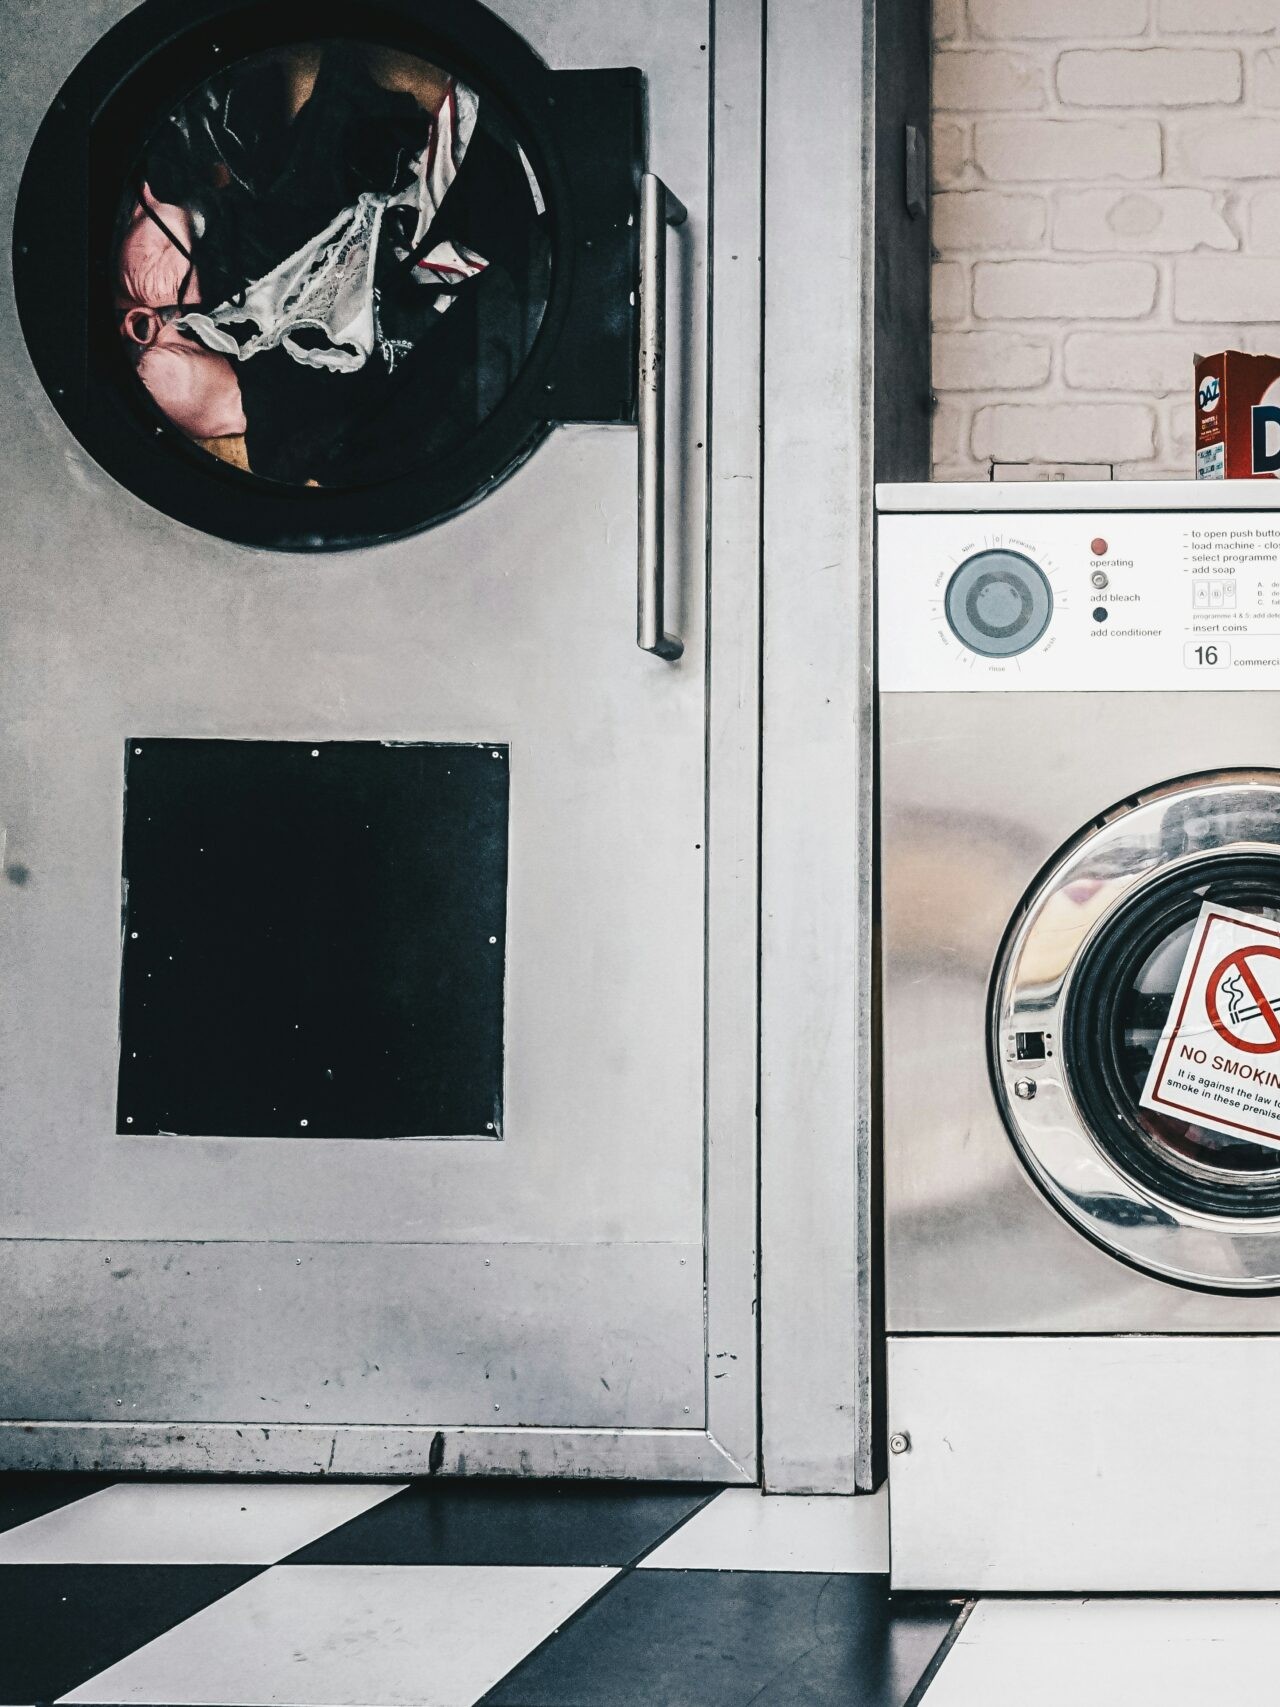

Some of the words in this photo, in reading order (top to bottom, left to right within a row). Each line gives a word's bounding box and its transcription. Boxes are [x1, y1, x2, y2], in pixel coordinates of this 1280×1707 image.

[1199, 378, 1219, 408] DAZ
[1191, 530, 1202, 538] to
[1203, 531, 1228, 539] open
[1229, 529, 1254, 540] push
[1191, 541, 1212, 550] load
[1214, 541, 1255, 550] machine
[1089, 559, 1134, 569] operating
[1191, 554, 1220, 562] select
[1222, 554, 1278, 564] programme
[1191, 565, 1210, 574] add
[1212, 567, 1236, 575] soap
[1090, 593, 1108, 602] add
[1109, 593, 1141, 602] bleach
[1090, 628, 1108, 637] add
[1110, 628, 1162, 637] conditioner
[1192, 624, 1220, 632] insert
[1195, 646, 1217, 665] 16
[1180, 1045, 1206, 1064] NO
[1178, 1069, 1185, 1077] It
[1187, 1072, 1195, 1080] is
[1198, 1077, 1234, 1094] against
[1237, 1088, 1252, 1099] the
[1255, 1094, 1272, 1105] law
[1167, 1079, 1199, 1094] smoke
[1202, 1090, 1210, 1098] in
[1214, 1093, 1240, 1107] these
